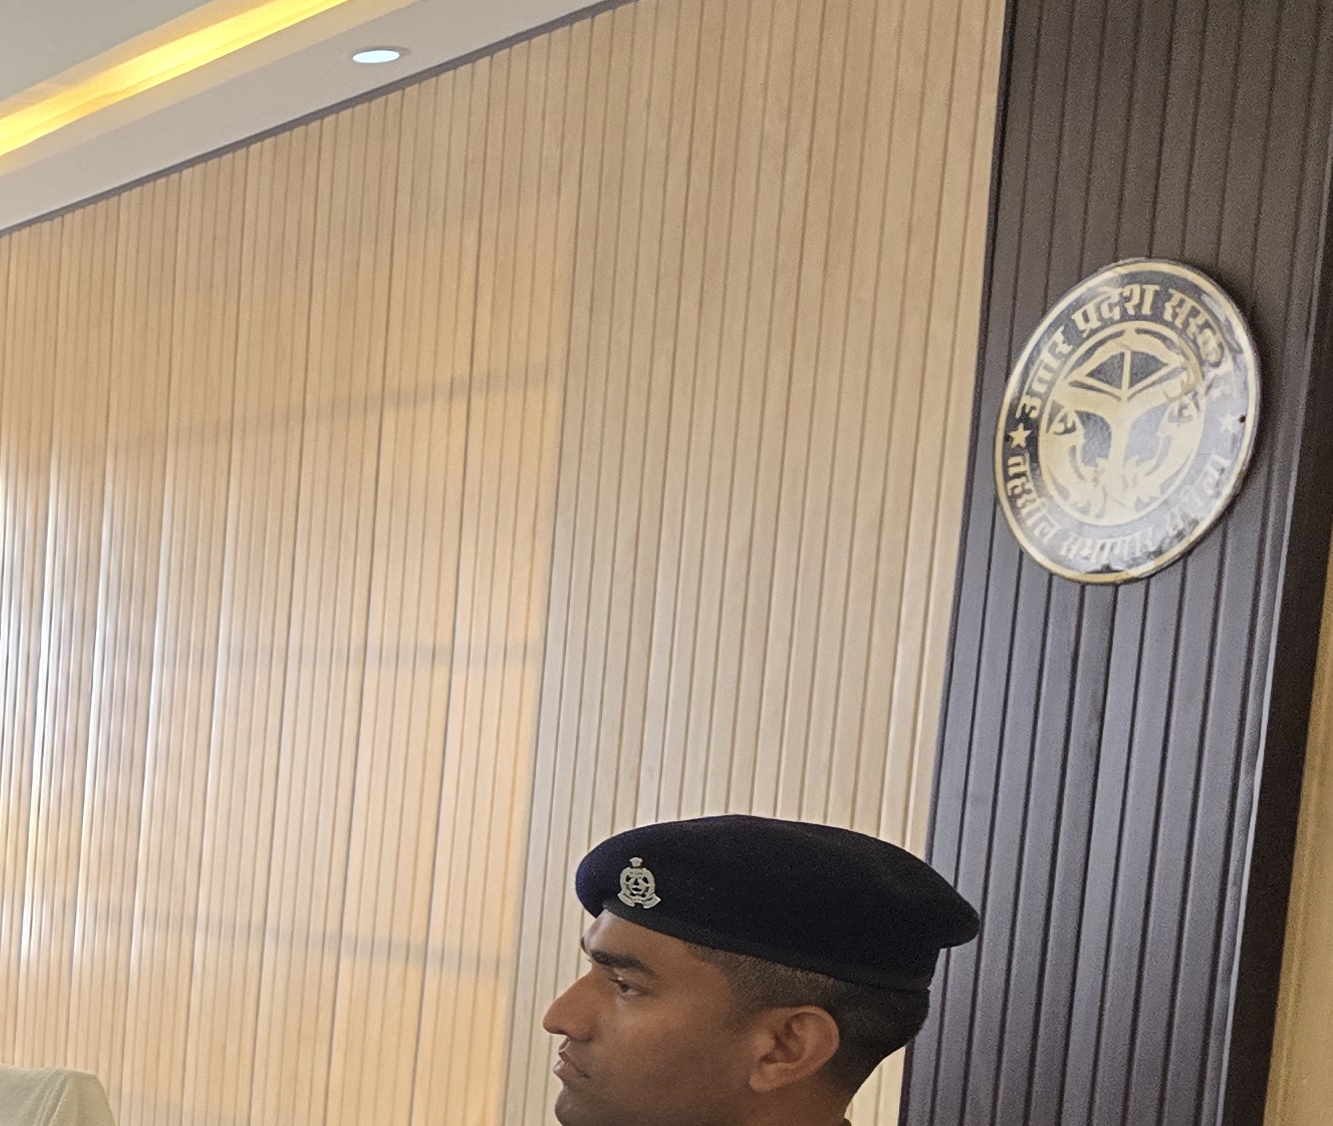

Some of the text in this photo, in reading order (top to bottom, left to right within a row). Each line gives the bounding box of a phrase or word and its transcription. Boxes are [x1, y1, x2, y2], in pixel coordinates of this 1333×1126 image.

[1016, 325, 1073, 418] उत्तर
[1071, 283, 1162, 338] प्रदेश
[1007, 452, 1062, 546] तहसील
